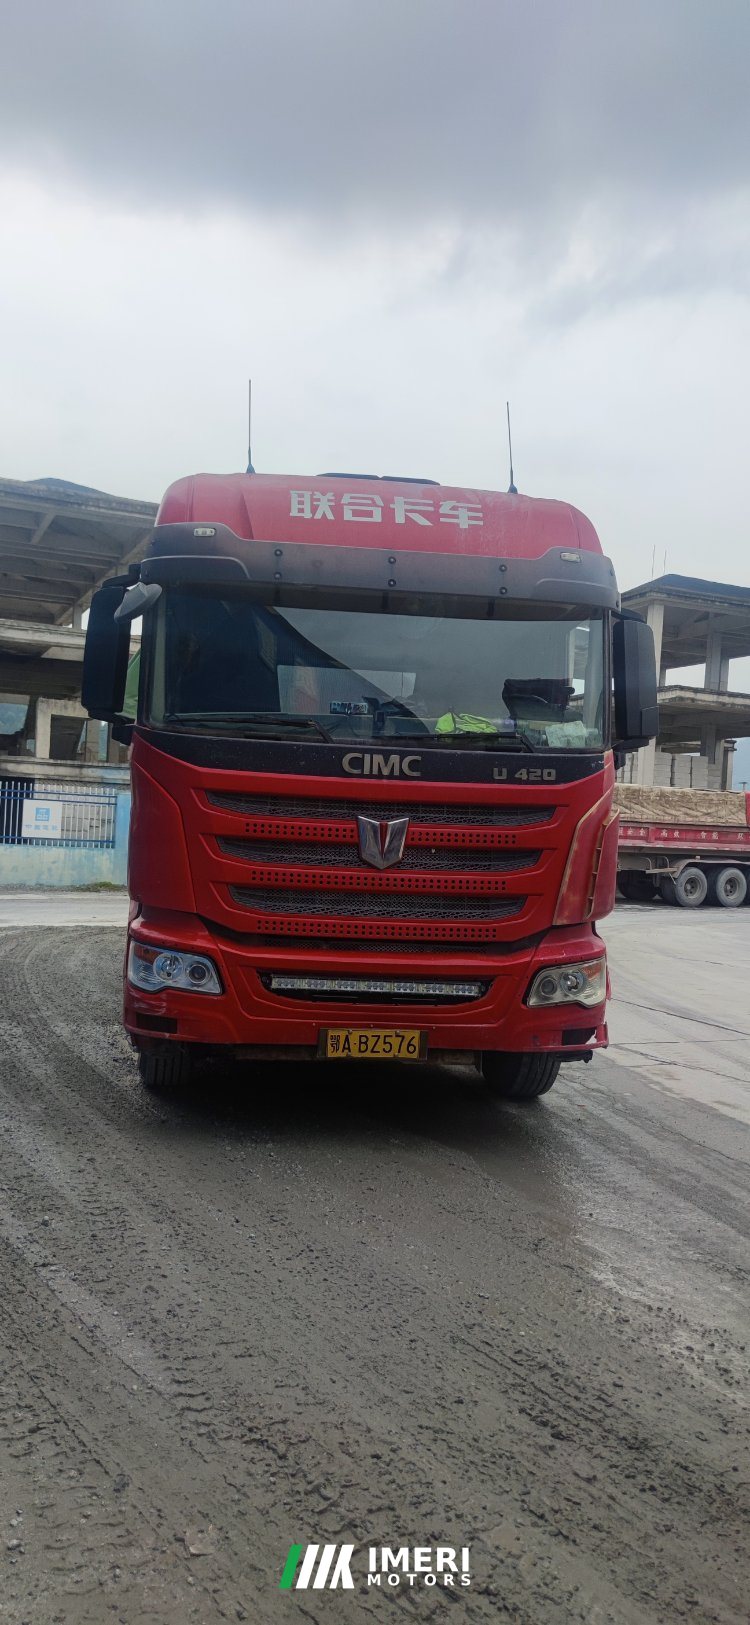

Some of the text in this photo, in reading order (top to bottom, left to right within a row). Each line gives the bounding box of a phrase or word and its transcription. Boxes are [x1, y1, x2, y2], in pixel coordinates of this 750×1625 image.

[289, 490, 484, 529] 联合卡车
[341, 752, 422, 777] CIMC
[492, 767, 556, 781] U 420
